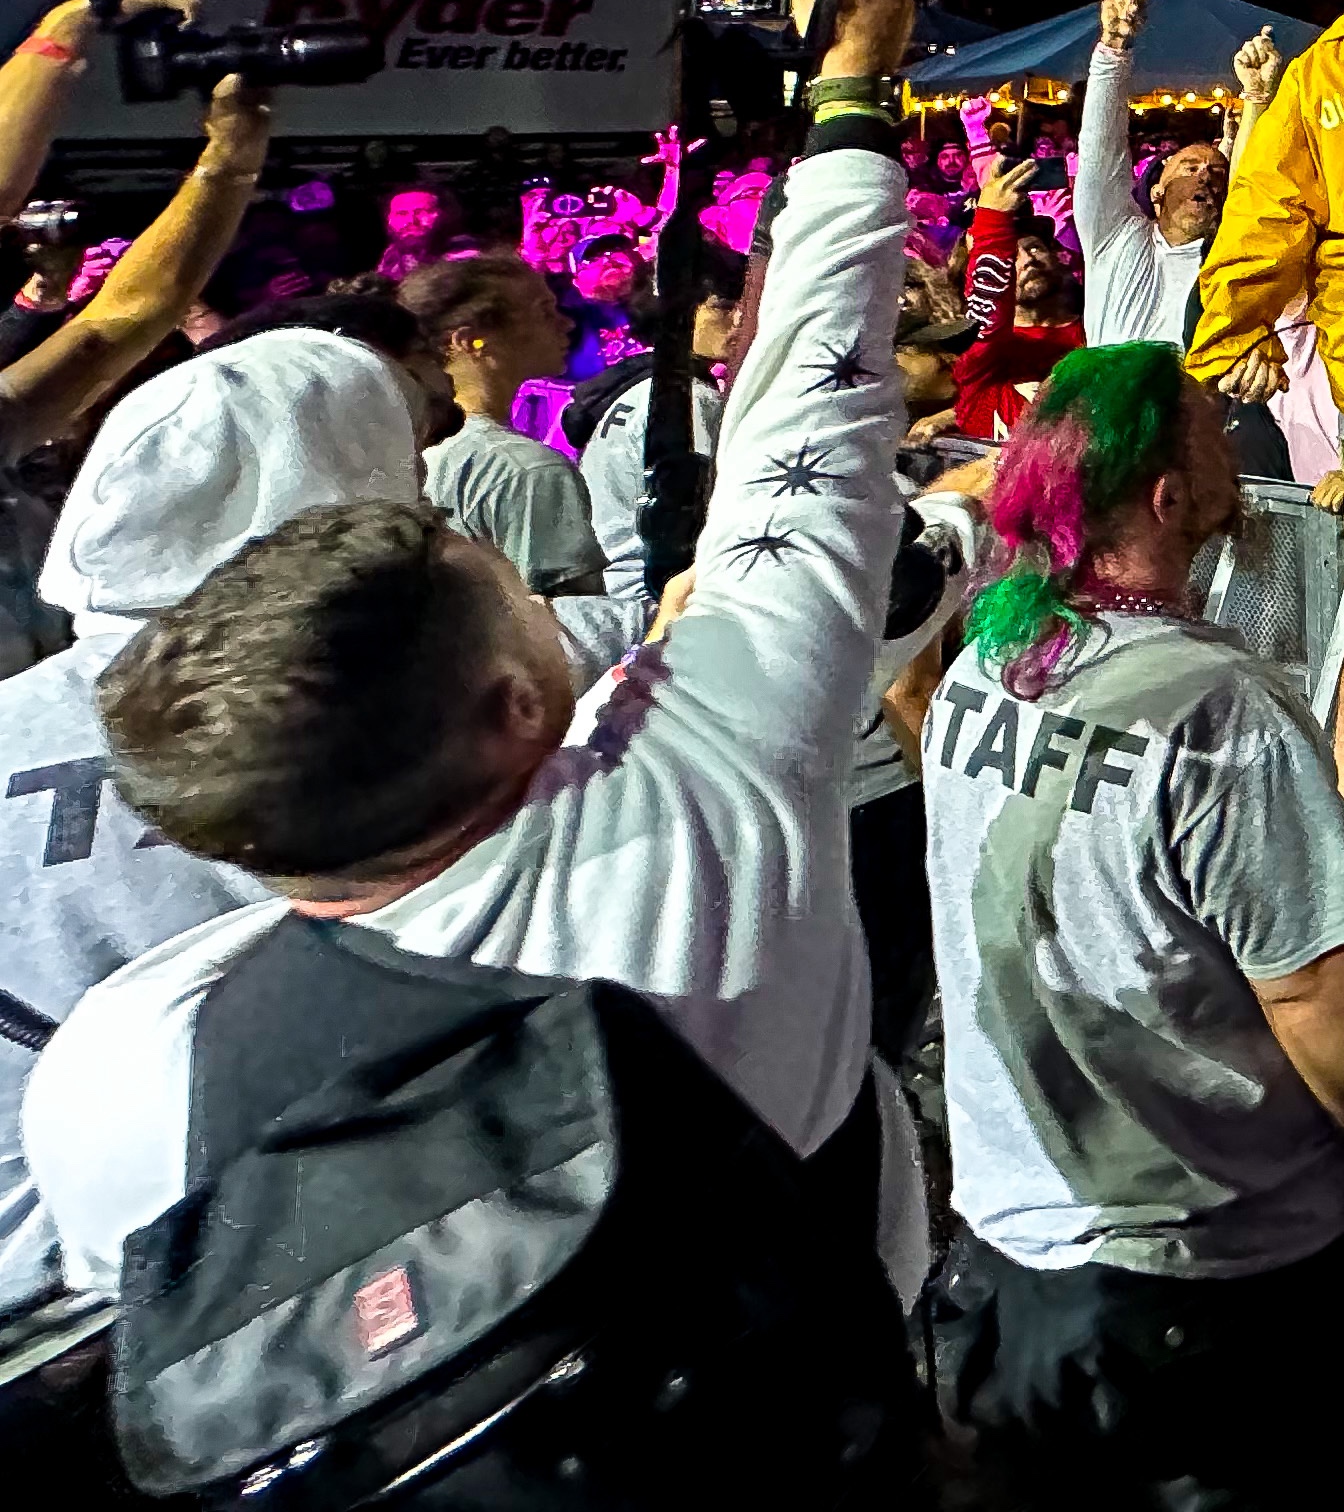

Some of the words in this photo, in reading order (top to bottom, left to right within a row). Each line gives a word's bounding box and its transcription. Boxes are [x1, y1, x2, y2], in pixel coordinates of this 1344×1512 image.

[395, 37, 497, 71] Ever
[501, 40, 629, 72] better.
[924, 678, 1150, 814] TAFF
